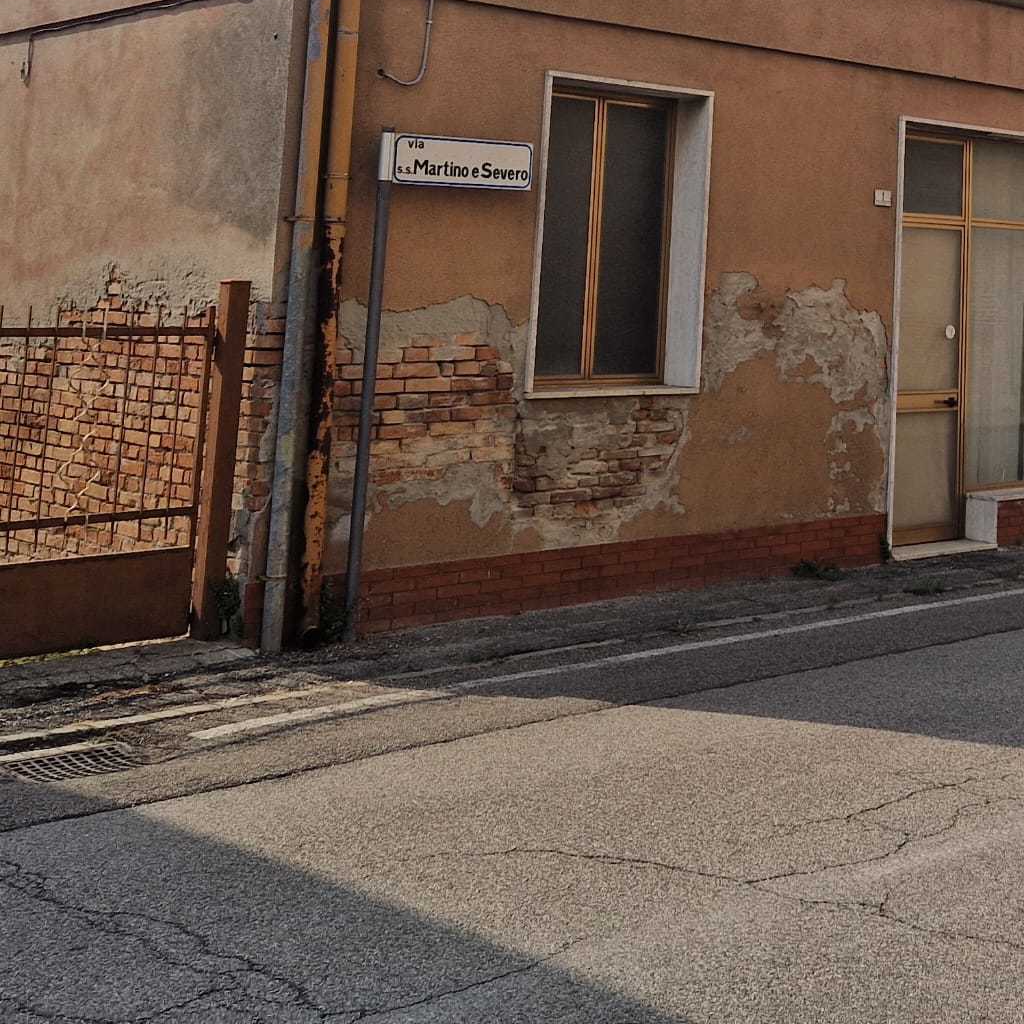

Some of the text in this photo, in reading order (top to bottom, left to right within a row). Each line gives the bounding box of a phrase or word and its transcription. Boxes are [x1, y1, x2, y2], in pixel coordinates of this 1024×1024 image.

[407, 138, 424, 149] via
[414, 159, 469, 178] Martino
[471, 166, 480, 178] e
[481, 162, 528, 181] Severo
